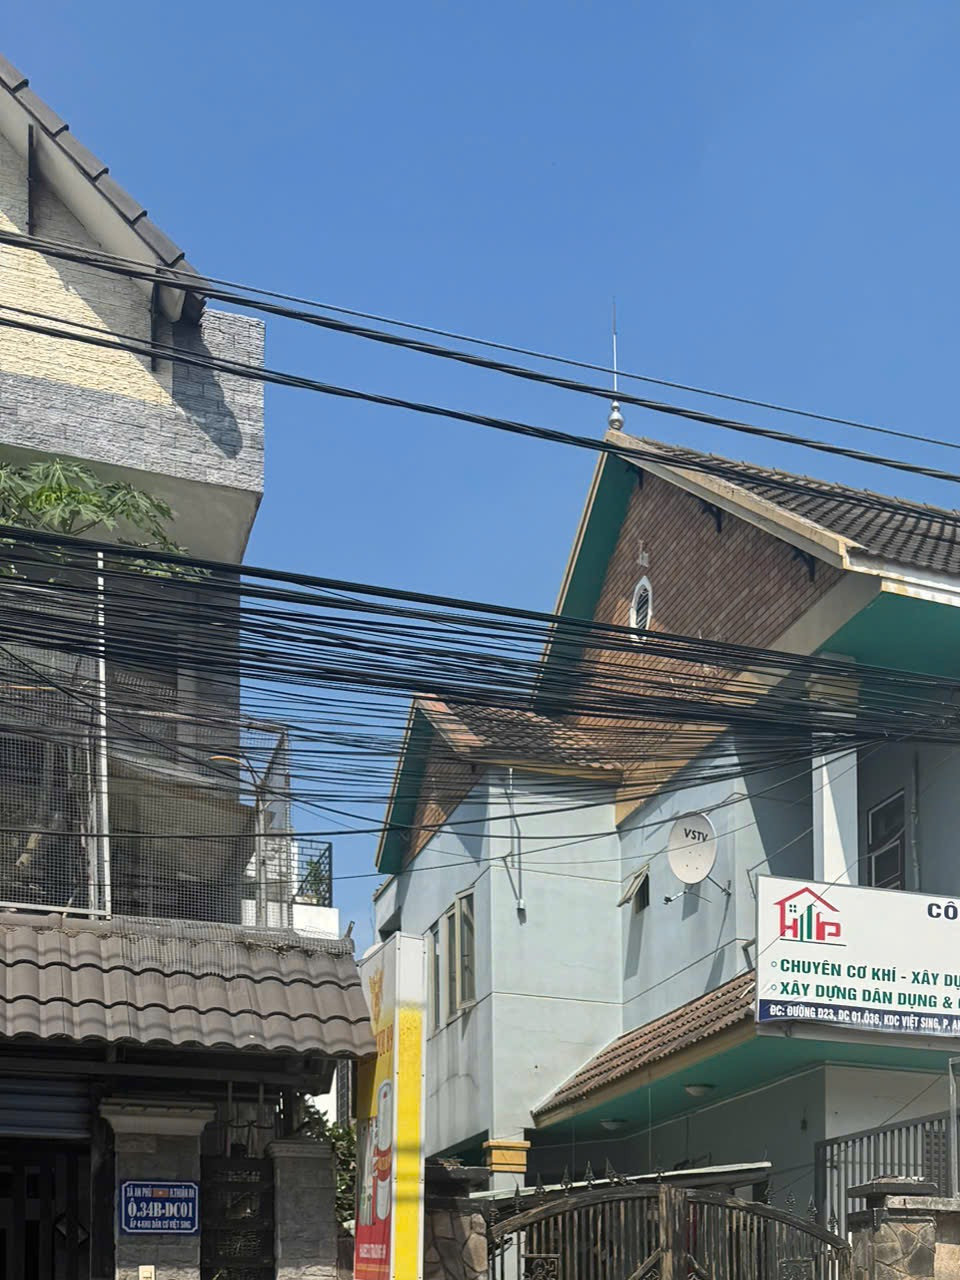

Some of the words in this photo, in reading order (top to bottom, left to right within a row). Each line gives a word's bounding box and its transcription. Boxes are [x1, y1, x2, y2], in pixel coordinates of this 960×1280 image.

[684, 828, 709, 843] VSTV
[780, 958, 842, 977] CHUYÊN
[846, 964, 868, 979] CƠ
[871, 966, 897, 982] KHÍ
[911, 969, 940, 985] XÂY
[780, 979, 810, 996] XÂY
[815, 984, 857, 1001] DỰNG
[862, 987, 893, 1005] DÂN
[897, 992, 938, 1009] DỤNG
[942, 996, 953, 1009] &
[769, 1005, 785, 1016] ĐC:
[786, 1003, 816, 1017] ĐƯỜNG
[817, 1008, 837, 1021] D23,
[838, 1009, 850, 1021] DC
[883, 1014, 900, 1027] KDC
[901, 1013, 920, 1029] VIỆT
[920, 1017, 941, 1030] SING,
[127, 1197, 193, 1218] Ô.34B-DC01
